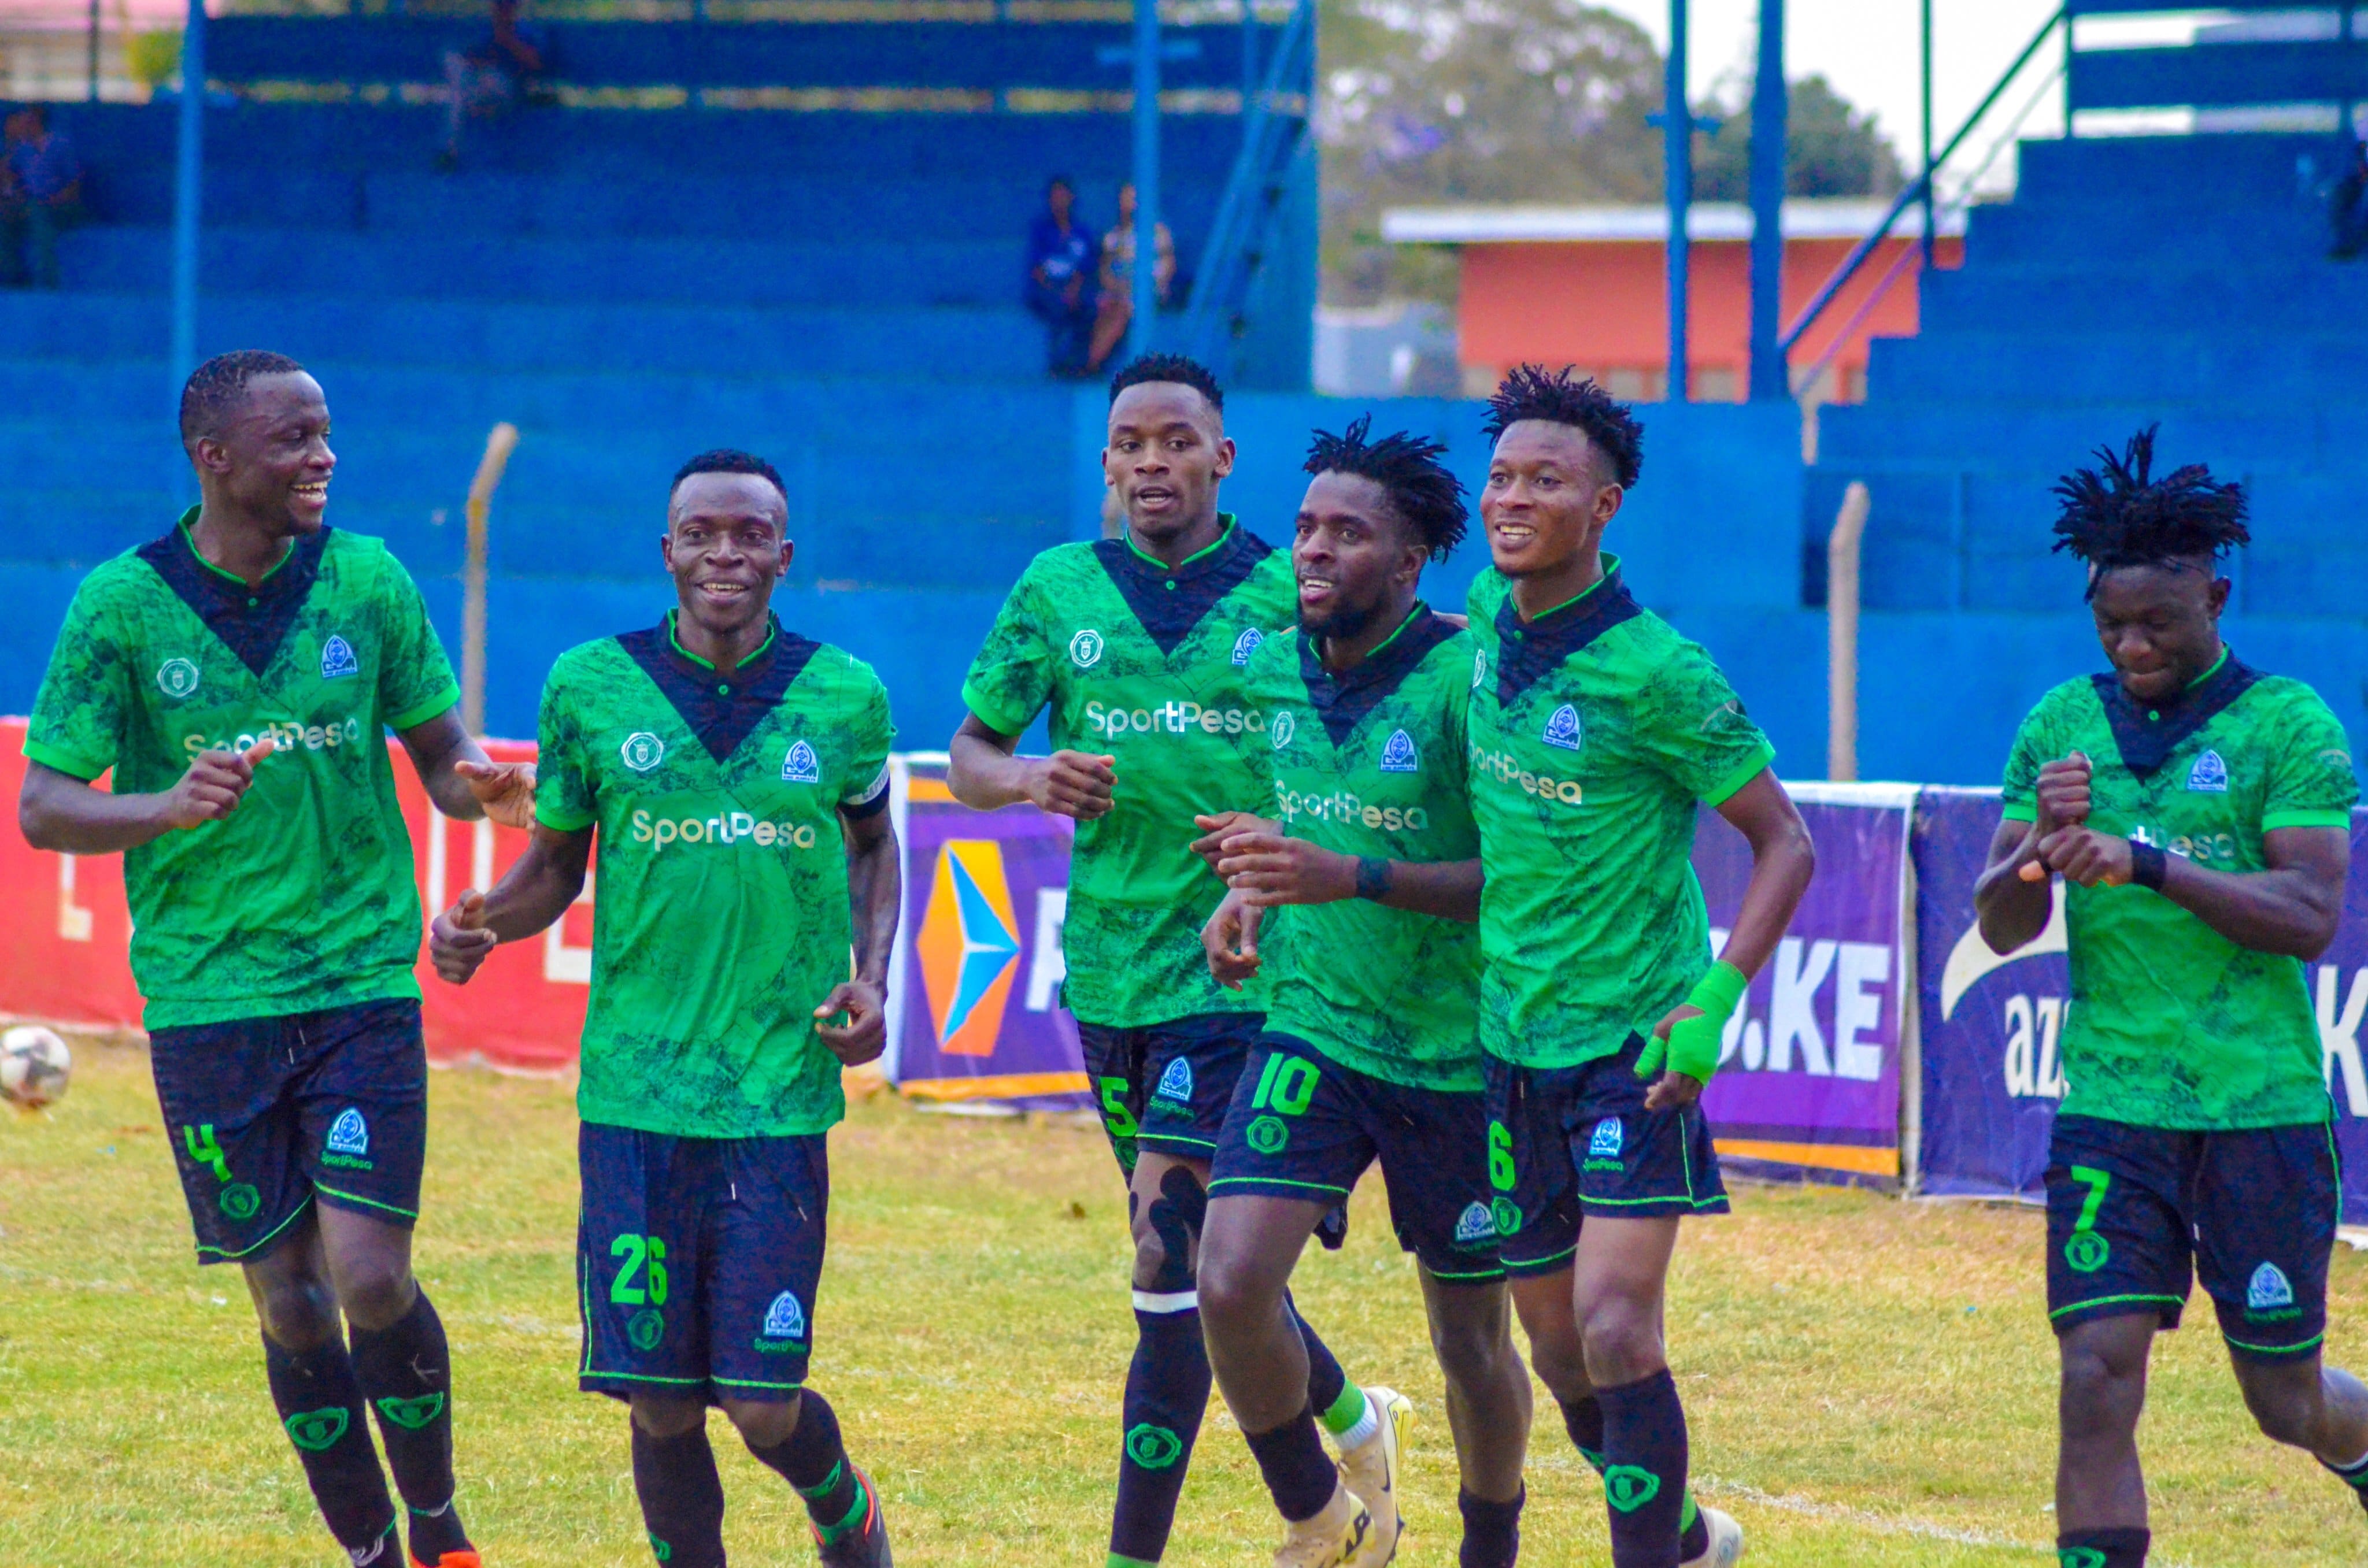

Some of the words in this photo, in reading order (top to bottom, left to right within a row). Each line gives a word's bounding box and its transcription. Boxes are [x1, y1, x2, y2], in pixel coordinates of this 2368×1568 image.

[1085, 700, 1266, 740] SportPesa
[632, 809, 816, 852] SportPesa
[1275, 779, 1428, 829] SportPesa
[2004, 993, 2072, 1098] az
[1099, 1077, 1138, 1137] 5
[1252, 1052, 1320, 1115] 10
[183, 1124, 232, 1183] 4
[1489, 1121, 1515, 1191] 6
[2072, 1166, 2110, 1230] 7
[610, 1234, 668, 1306] 26
